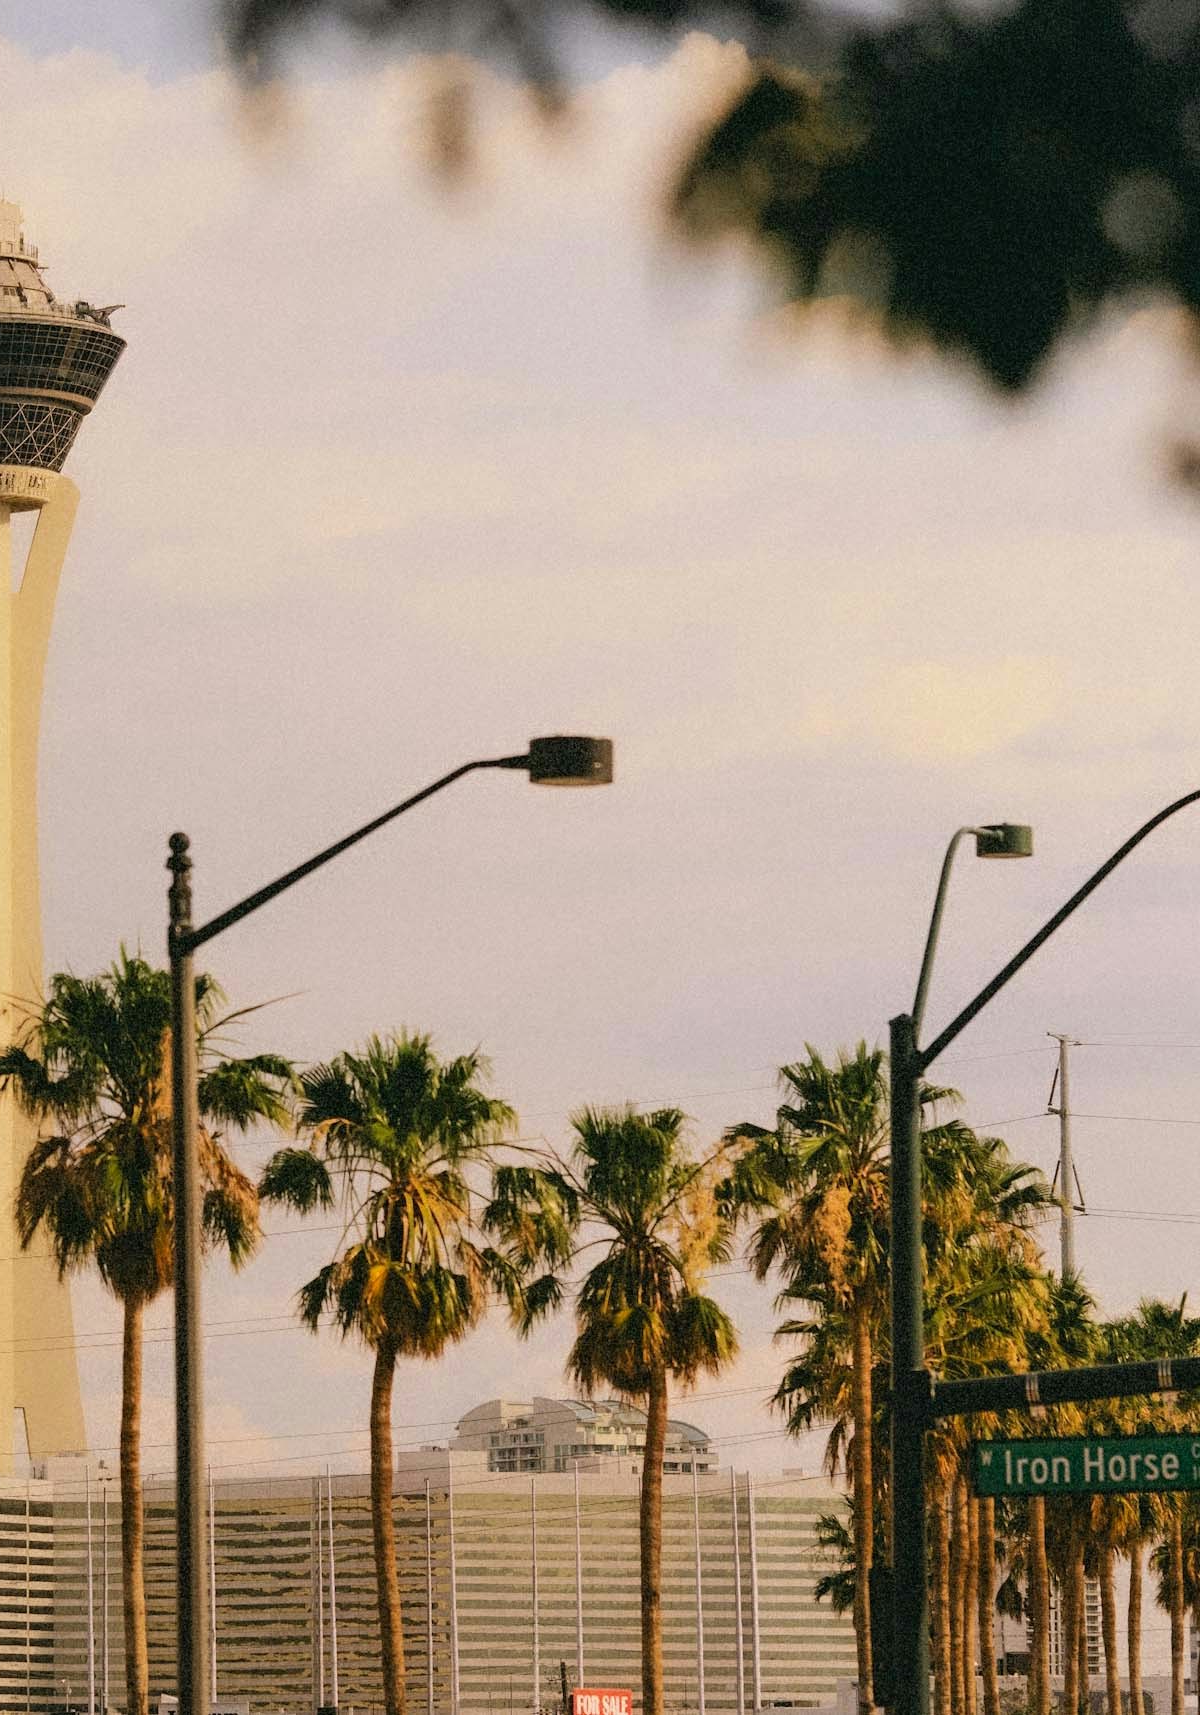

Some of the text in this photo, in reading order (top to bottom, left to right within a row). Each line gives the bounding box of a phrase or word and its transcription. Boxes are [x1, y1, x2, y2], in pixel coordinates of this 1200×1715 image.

[979, 1450, 993, 1466] W
[1005, 1450, 1071, 1485] Iron
[1084, 1446, 1180, 1482] Horse
[576, 1694, 629, 1715] FOR SALE
